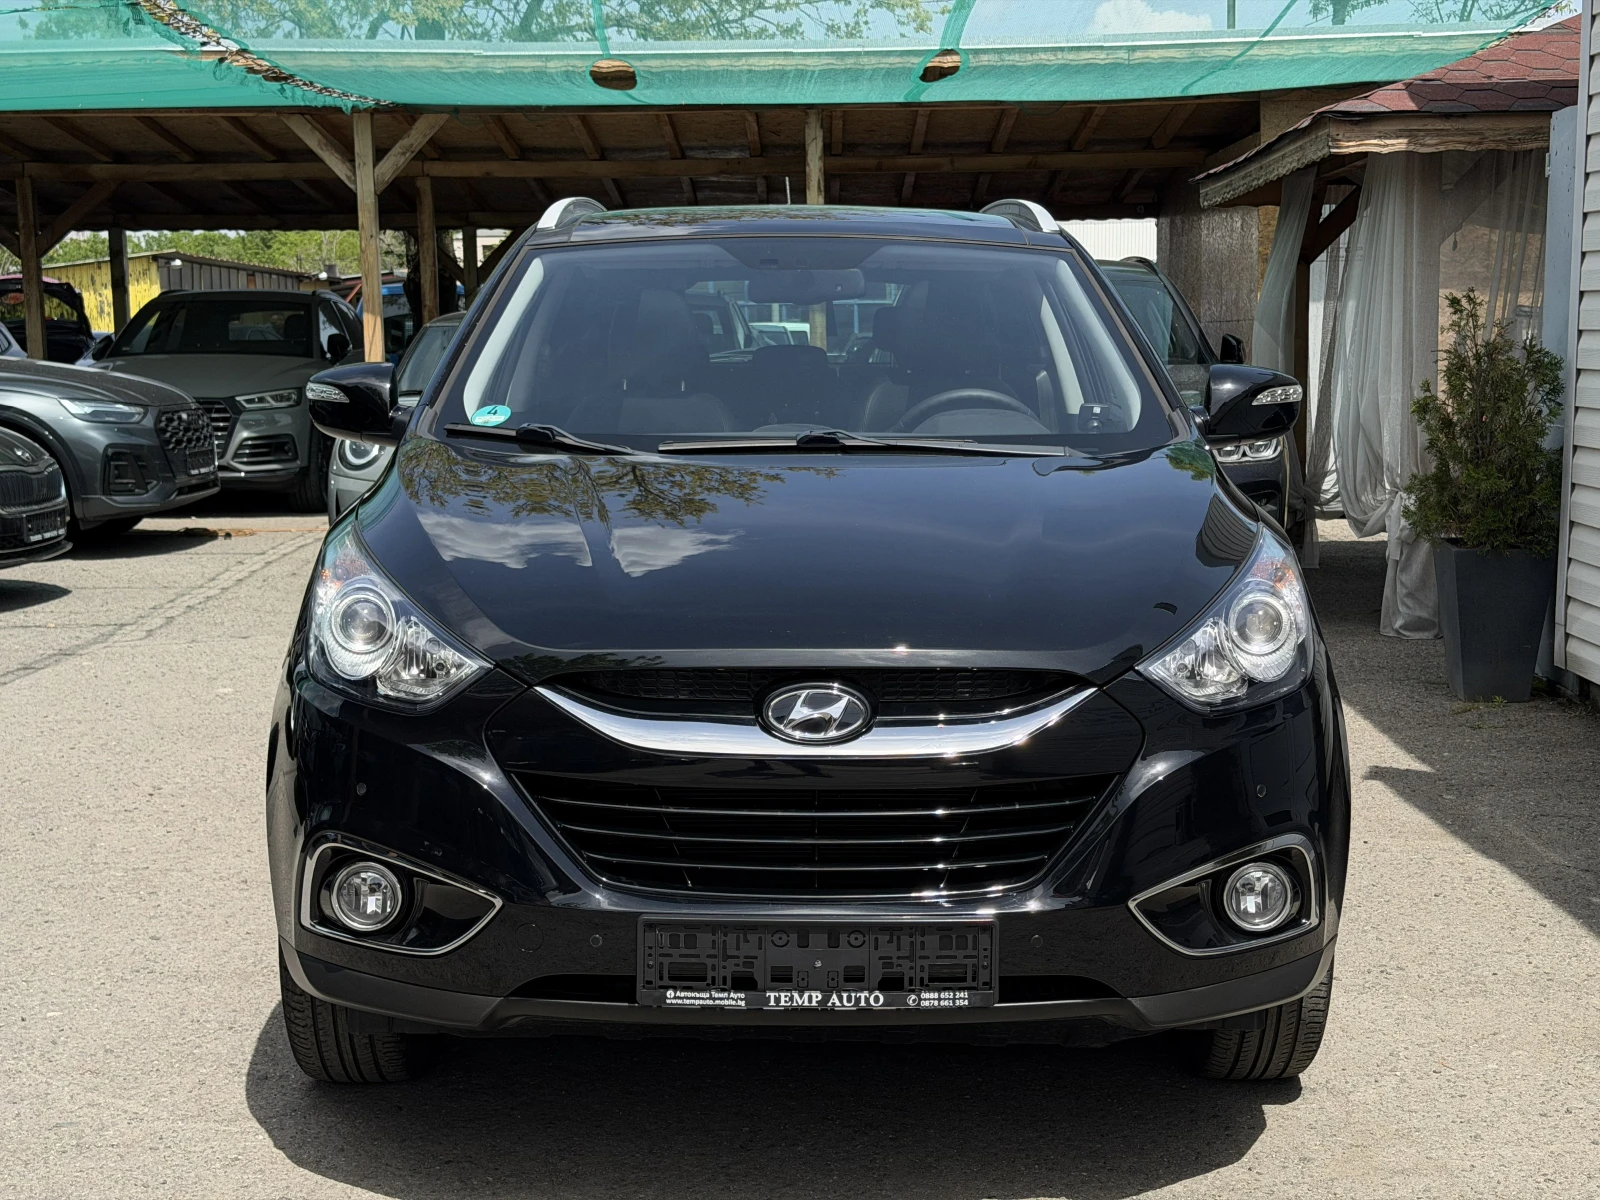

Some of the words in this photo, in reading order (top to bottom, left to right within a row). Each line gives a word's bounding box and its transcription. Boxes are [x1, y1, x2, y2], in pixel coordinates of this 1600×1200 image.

[487, 406, 498, 415] 4
[766, 992, 822, 1006] TEMP
[827, 992, 884, 1006] AUTO
